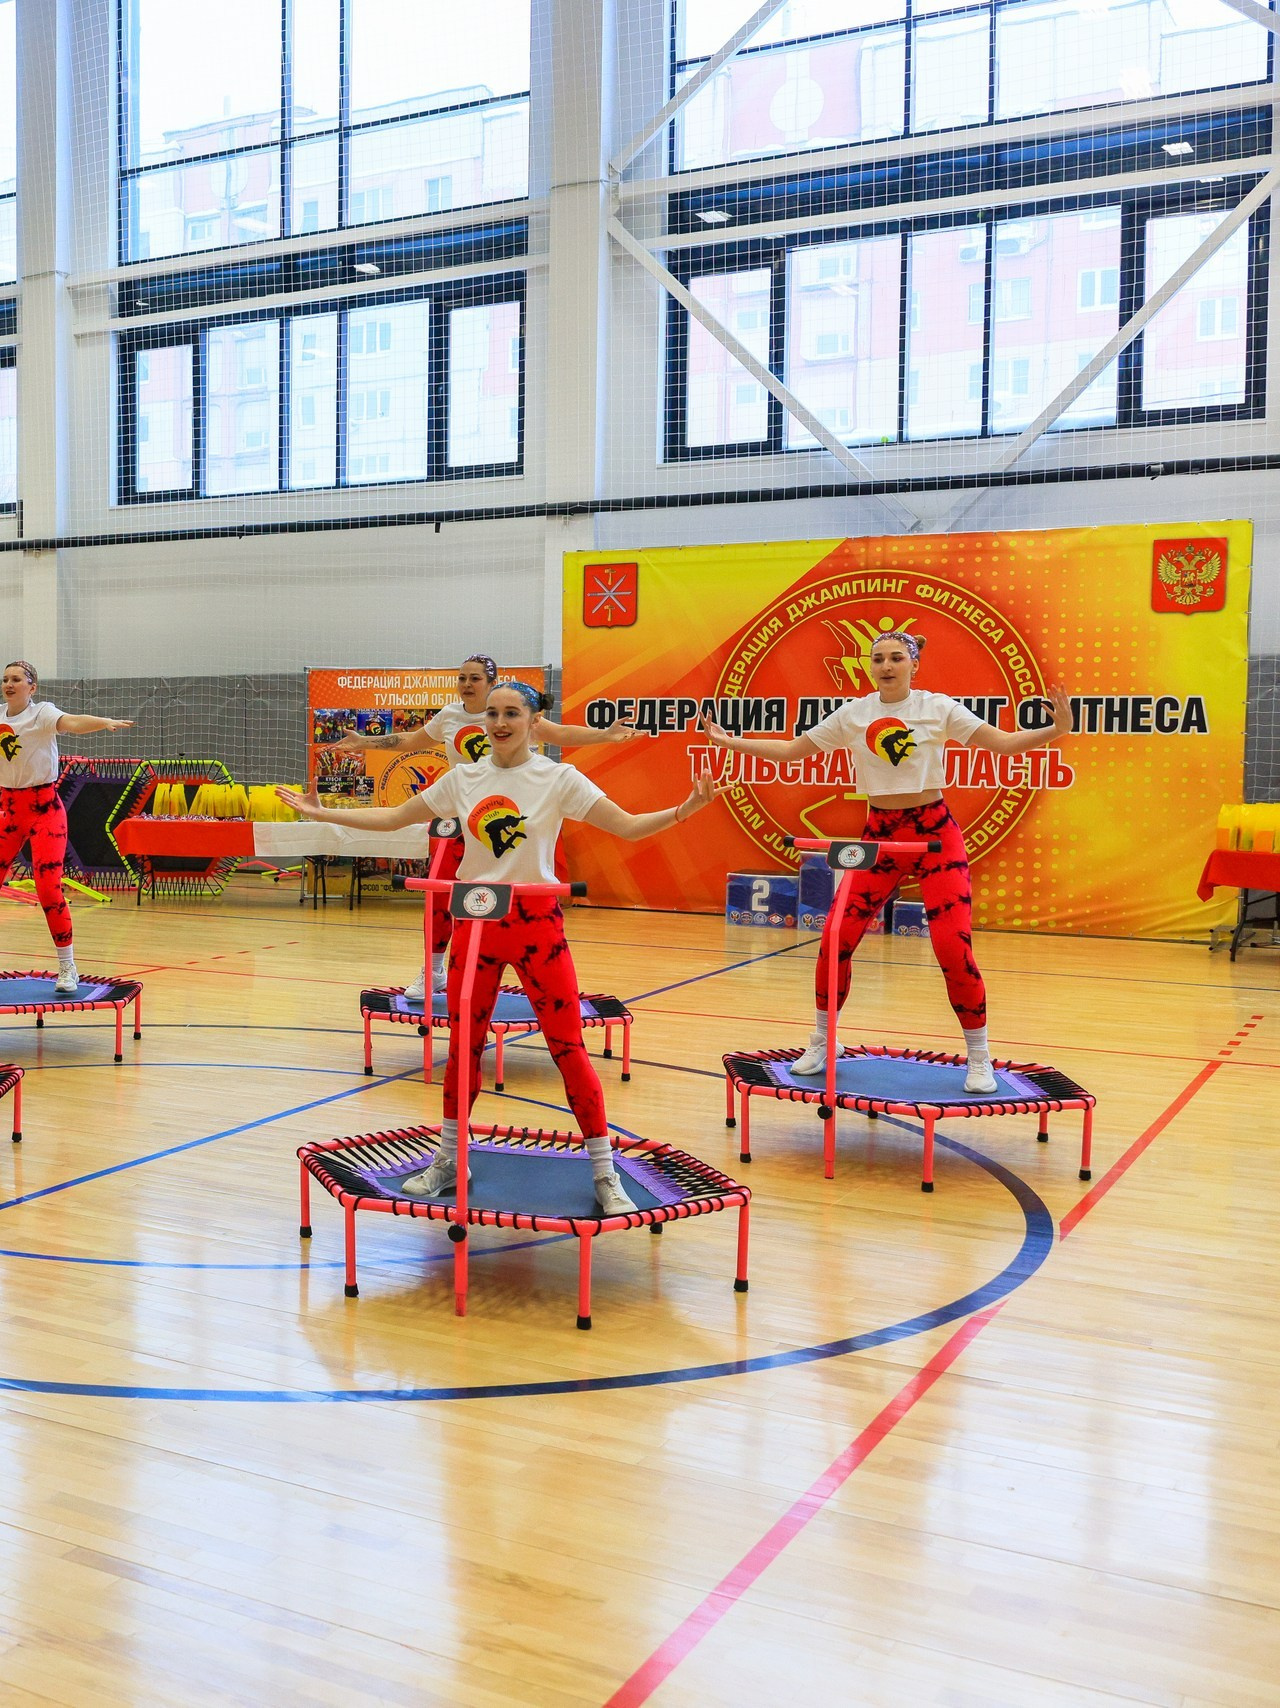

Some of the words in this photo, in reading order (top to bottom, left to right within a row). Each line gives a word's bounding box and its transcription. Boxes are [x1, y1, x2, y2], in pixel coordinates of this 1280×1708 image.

[785, 579, 909, 623] ДЖАМПИНГ
[915, 584, 1005, 645] ФИТНЕСА
[1000, 642, 1037, 698] РОСС
[338, 675, 401, 689] ФЕДЕРАЦИЯ
[403, 675, 459, 689] ДЖАМПИН
[374, 692, 428, 706] ТУЛЬСКОЙ
[431, 693, 461, 706] ОБЛА
[586, 697, 785, 738] ФЕДЕРАЦИЯ
[688, 746, 857, 785] ТУЛЬСКА
[945, 748, 1074, 788] ЛАСТЬ
[471, 798, 505, 821] Jumping
[483, 810, 500, 821] Club
[751, 879, 770, 912] 2
